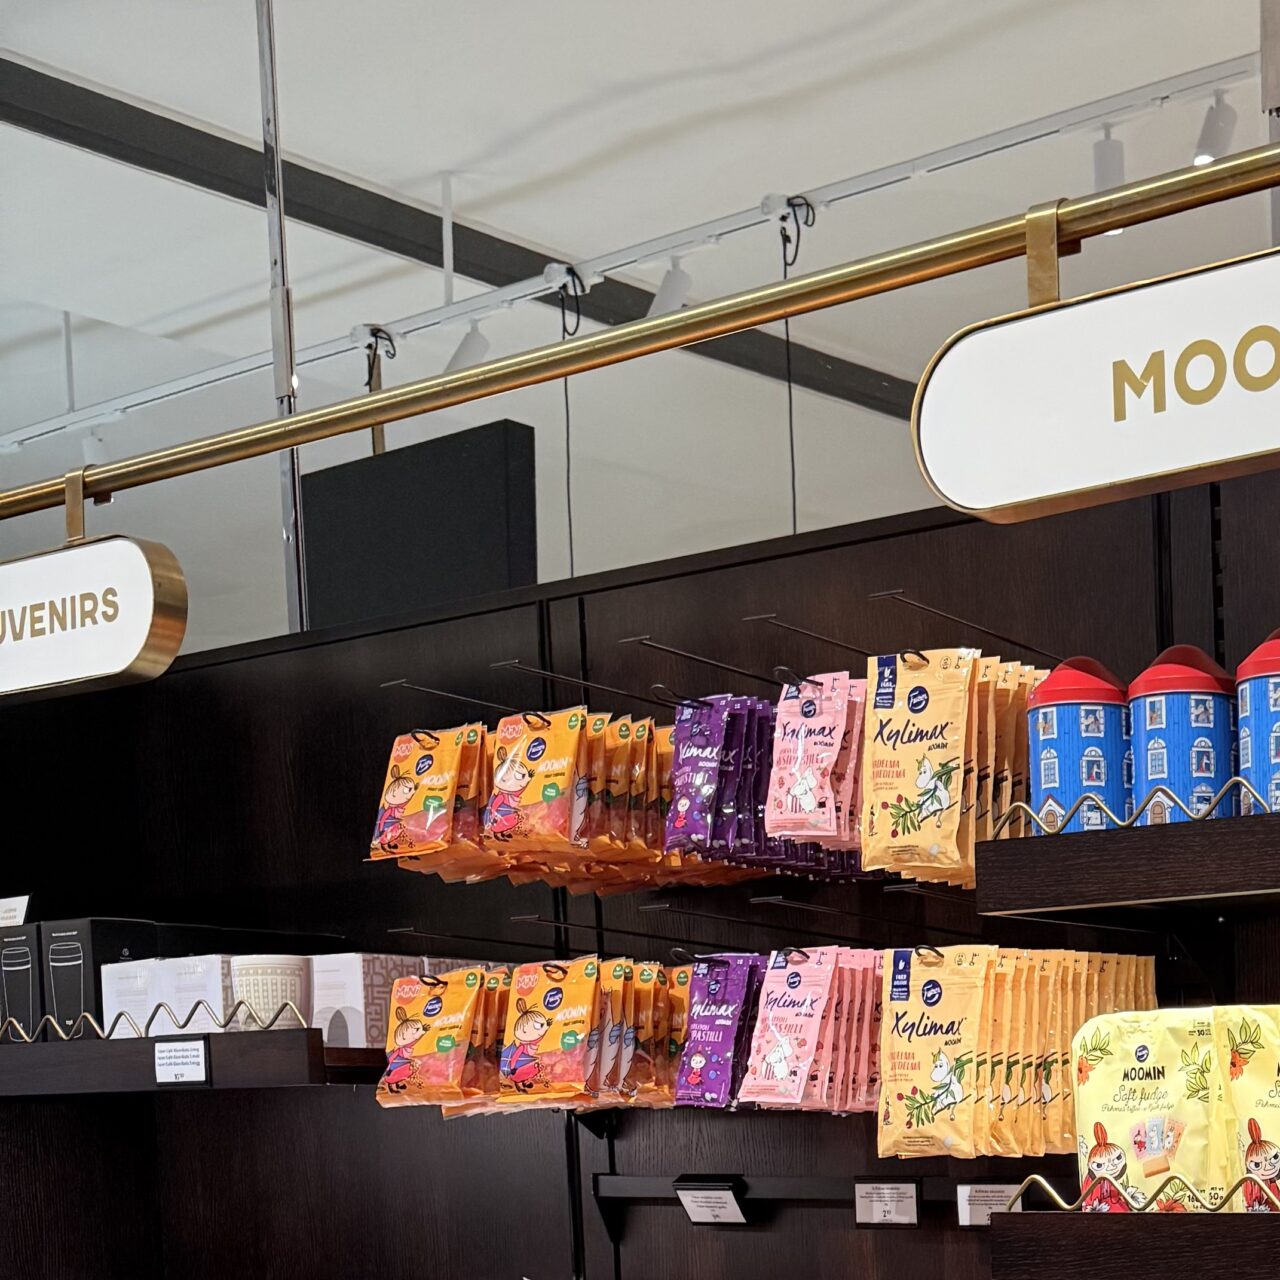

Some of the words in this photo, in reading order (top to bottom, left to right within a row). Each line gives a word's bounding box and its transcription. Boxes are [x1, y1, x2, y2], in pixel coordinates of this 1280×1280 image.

[0, 587, 119, 645] VENIRS
[873, 718, 949, 751] Xylimax
[891, 1011, 963, 1042] Xylimax
[1122, 1066, 1165, 1082] MOOMIN
[1113, 1085, 1136, 1105] Soft
[1138, 1085, 1169, 1104] fudge
